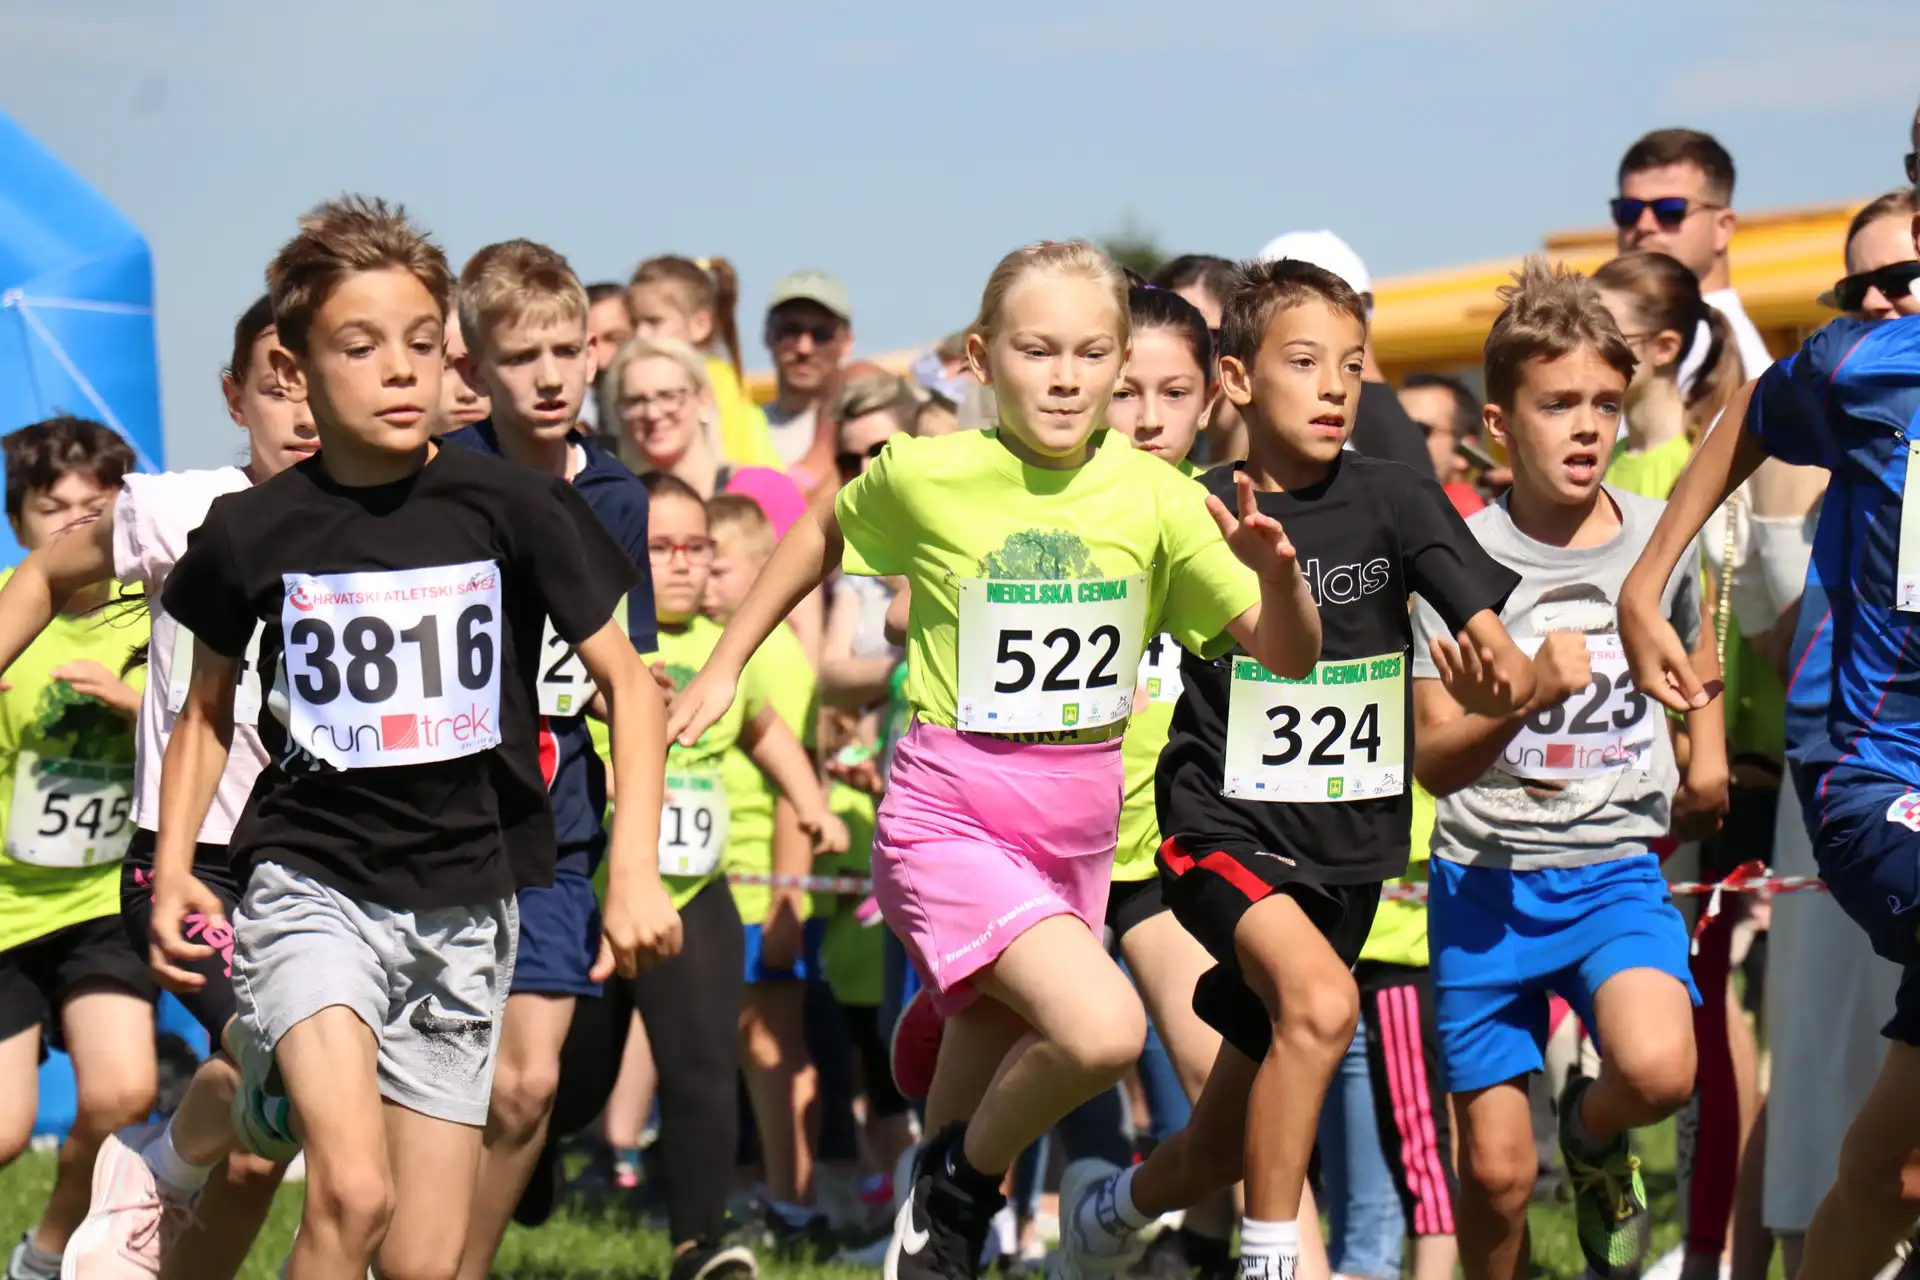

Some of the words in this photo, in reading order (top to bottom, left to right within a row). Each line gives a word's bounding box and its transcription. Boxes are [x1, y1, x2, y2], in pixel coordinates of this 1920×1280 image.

[313, 590, 380, 606] HRVATSKI
[384, 584, 453, 602] ATLETSKI
[986, 582, 1074, 605] NEDELSKA
[1078, 579, 1128, 603] CENKA
[290, 603, 495, 706] 3816
[994, 624, 1122, 694] 522
[1322, 662, 1368, 686] CENKA
[1370, 658, 1402, 682] 2023
[311, 724, 381, 752] run
[421, 703, 493, 747] trek
[1262, 703, 1381, 766] 324
[1503, 746, 1544, 767] un
[1577, 736, 1634, 768] trek
[38, 793, 130, 839] 545
[667, 806, 713, 848] 19
